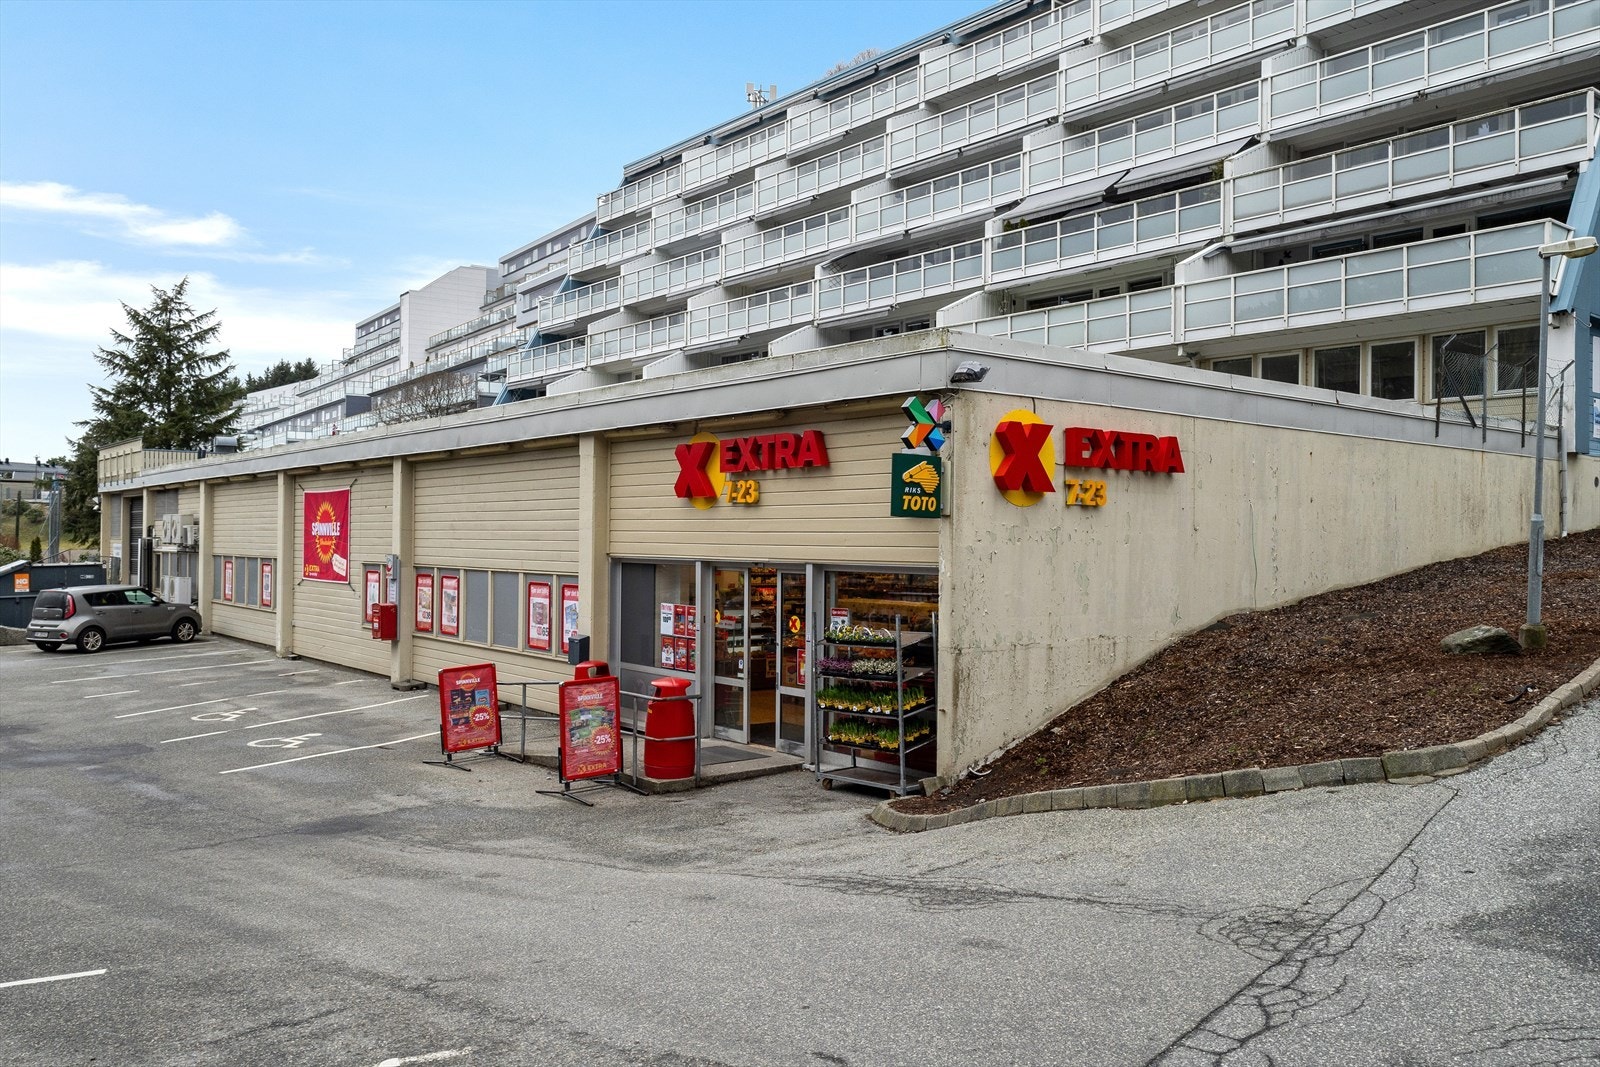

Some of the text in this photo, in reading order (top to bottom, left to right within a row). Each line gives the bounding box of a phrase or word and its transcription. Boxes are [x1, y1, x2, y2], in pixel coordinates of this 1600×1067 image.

[674, 430, 829, 498] X EXTRA
[993, 421, 1185, 493] X EXTRA
[724, 480, 760, 504] 7-23
[1064, 479, 1107, 507] 7-23
[902, 495, 937, 512] TOTO
[311, 522, 340, 536] SPINNVILLE
[455, 677, 481, 686] SPINNVILLE
[473, 712, 490, 722] -25%
[594, 734, 612, 745] -25%
